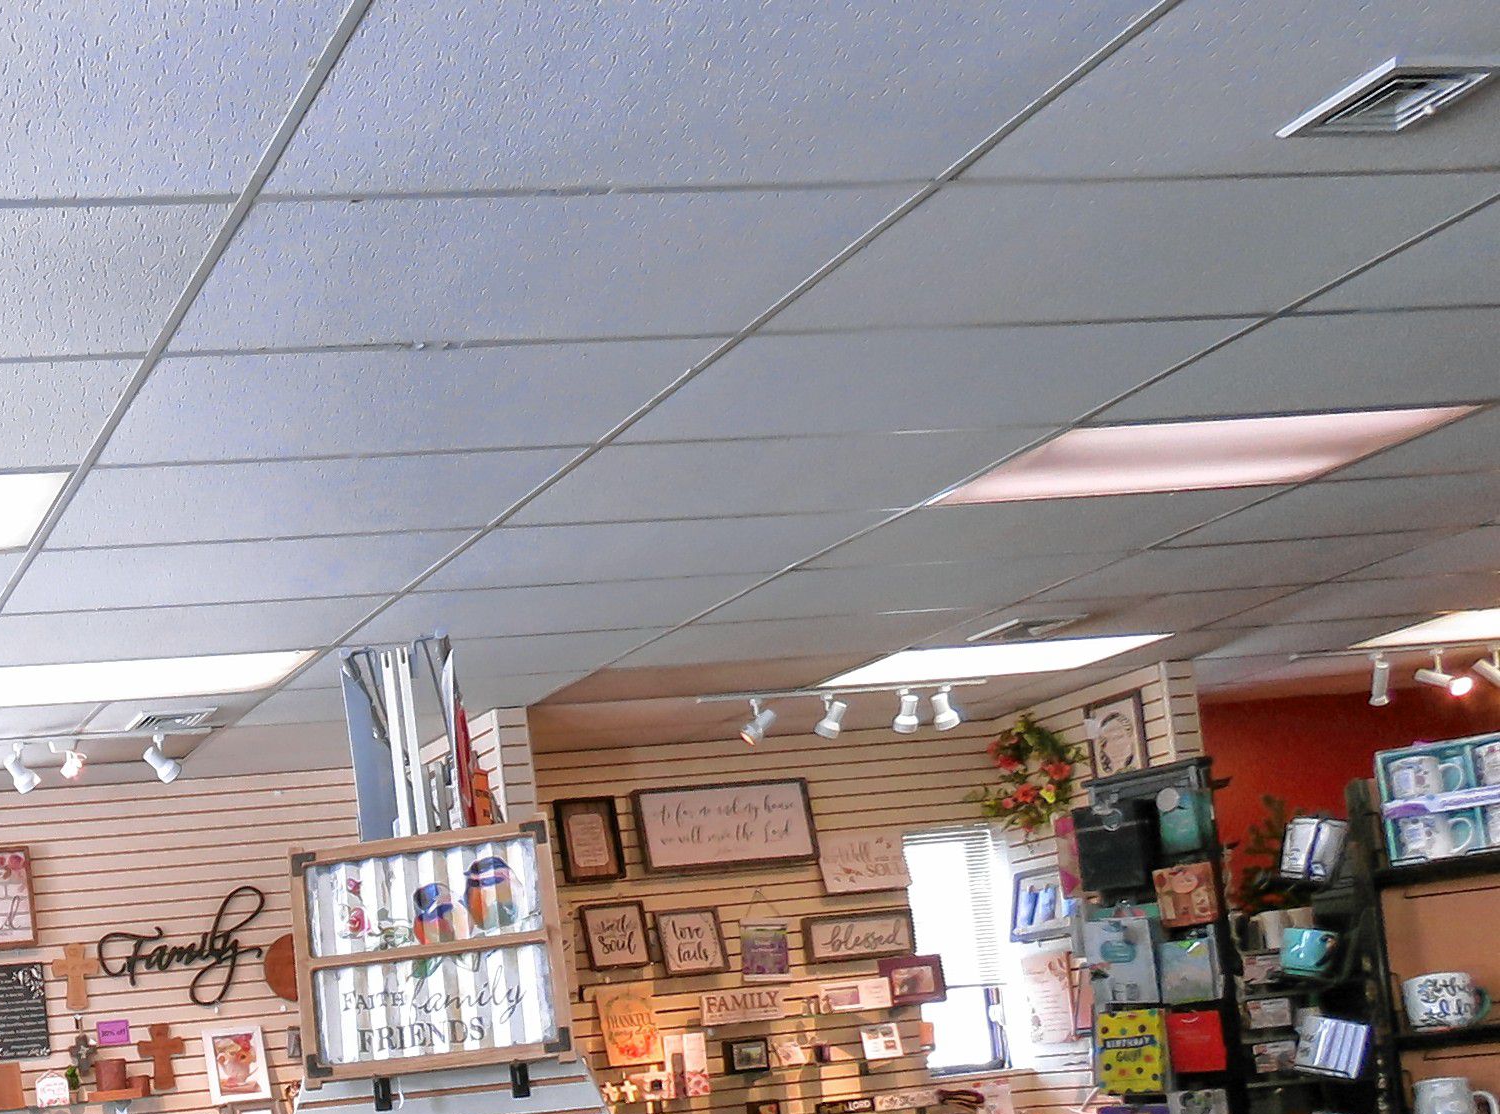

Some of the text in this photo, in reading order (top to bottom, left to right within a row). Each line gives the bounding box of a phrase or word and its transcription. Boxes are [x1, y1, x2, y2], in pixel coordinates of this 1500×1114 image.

[98, 886, 265, 1005] Family
[671, 920, 704, 940] love
[821, 919, 903, 952] blessed
[409, 964, 526, 1026] family
[706, 990, 780, 1013] FAMILY
[357, 1015, 485, 1053] FRIENDS
